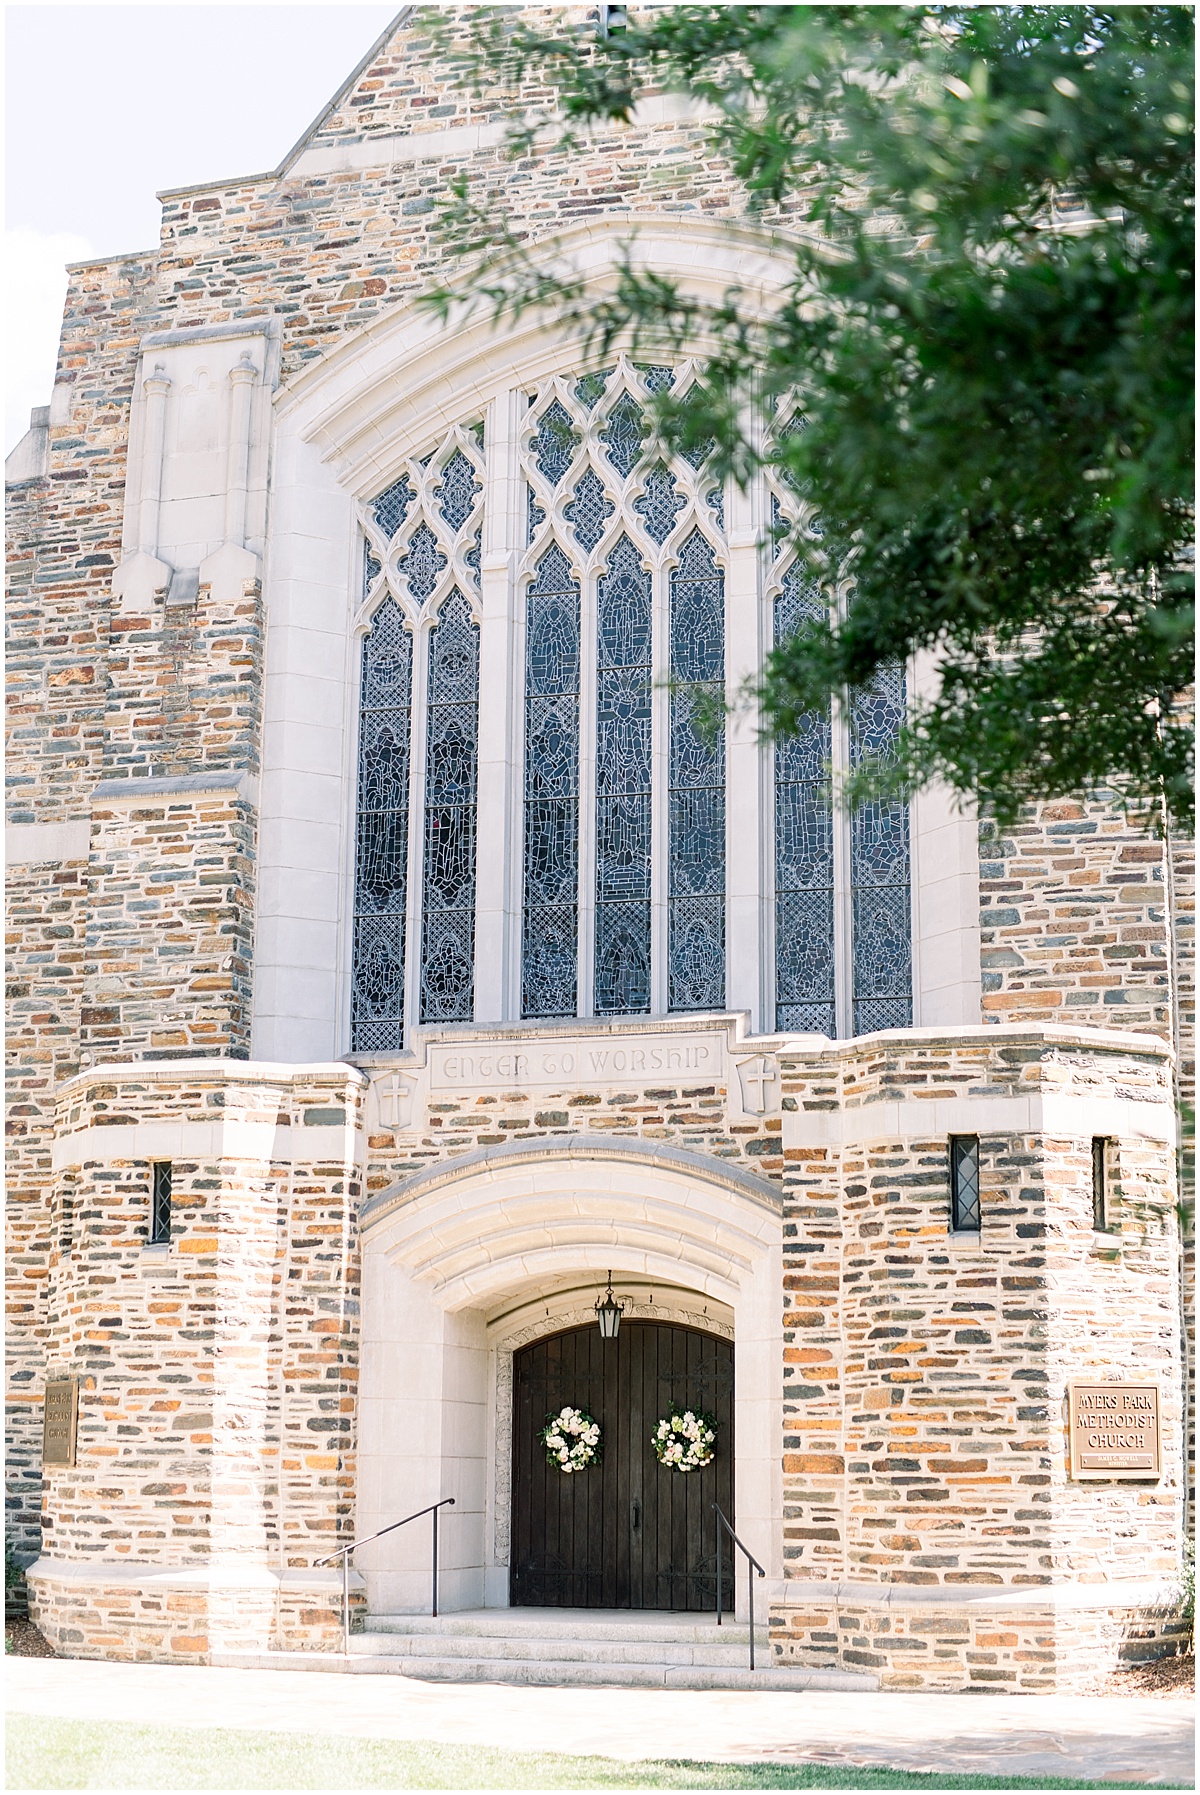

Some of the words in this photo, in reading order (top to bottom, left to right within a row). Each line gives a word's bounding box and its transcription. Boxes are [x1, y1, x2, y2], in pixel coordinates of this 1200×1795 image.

[443, 1054, 529, 1079] ENTER
[542, 1052, 575, 1075] TO
[588, 1045, 710, 1073] WORSHIP
[1078, 1394, 1118, 1410] MYERS
[1122, 1394, 1153, 1410] PARK
[1076, 1413, 1155, 1429] METHODIST
[1088, 1433, 1145, 1448] CHURCH
